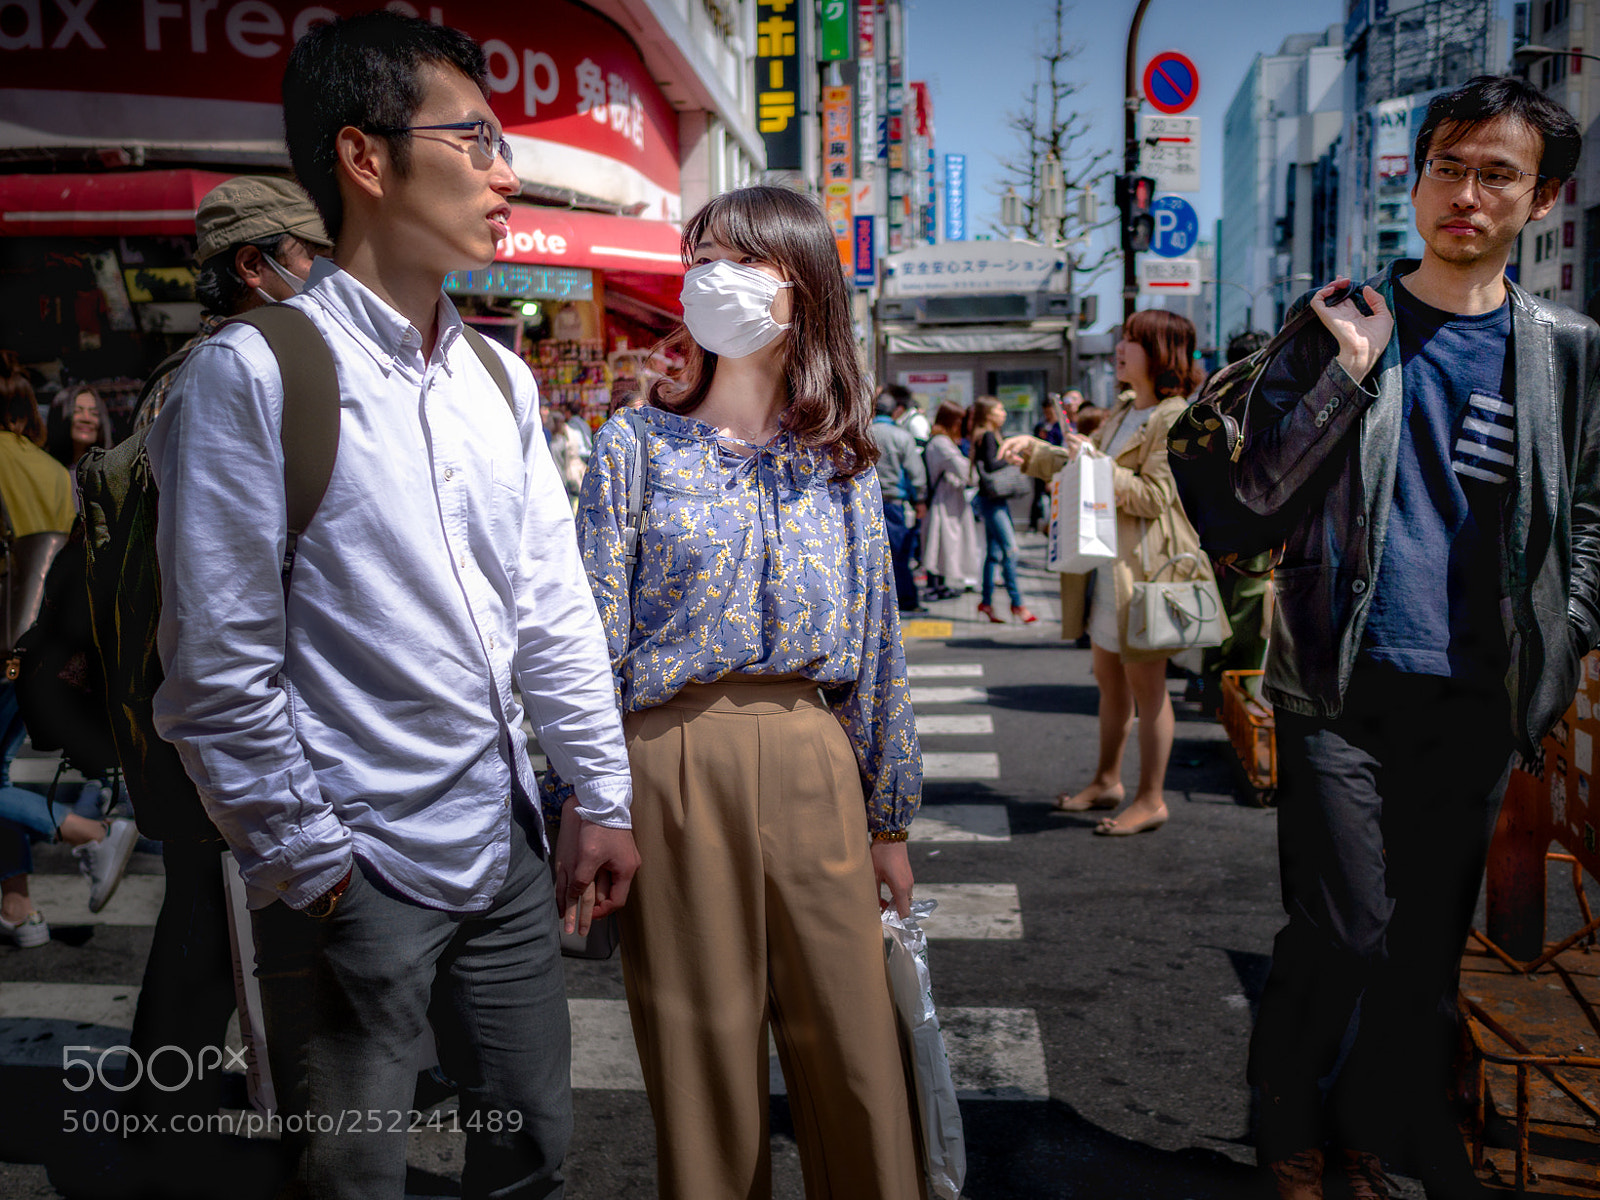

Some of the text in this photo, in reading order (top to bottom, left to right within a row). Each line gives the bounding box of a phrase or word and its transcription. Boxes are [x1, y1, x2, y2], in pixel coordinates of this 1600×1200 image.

[497, 229, 567, 257] jote
[1154, 210, 1177, 249] P
[902, 259, 1050, 275] 安全安心ステーション
